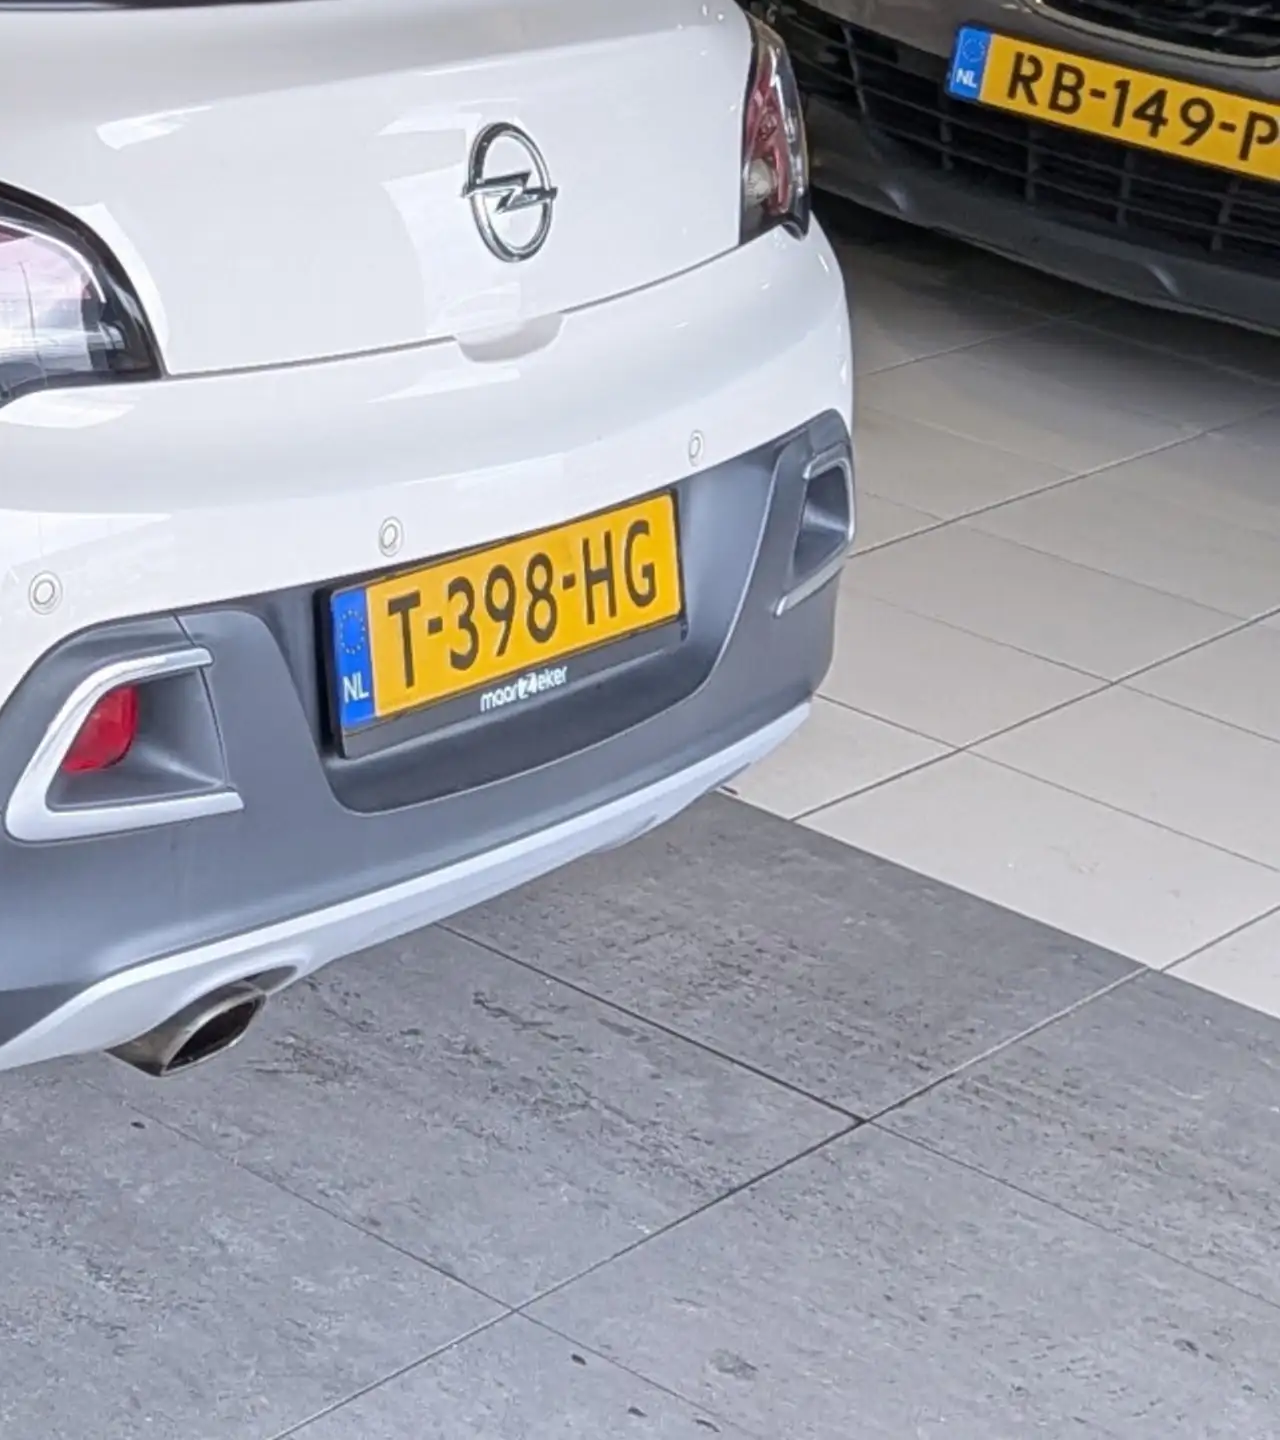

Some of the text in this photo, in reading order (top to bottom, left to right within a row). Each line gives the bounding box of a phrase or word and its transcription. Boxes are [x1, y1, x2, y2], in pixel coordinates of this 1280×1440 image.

[956, 50, 1280, 162] NL RB-149-P
[342, 518, 657, 704] NL T-398-HG
